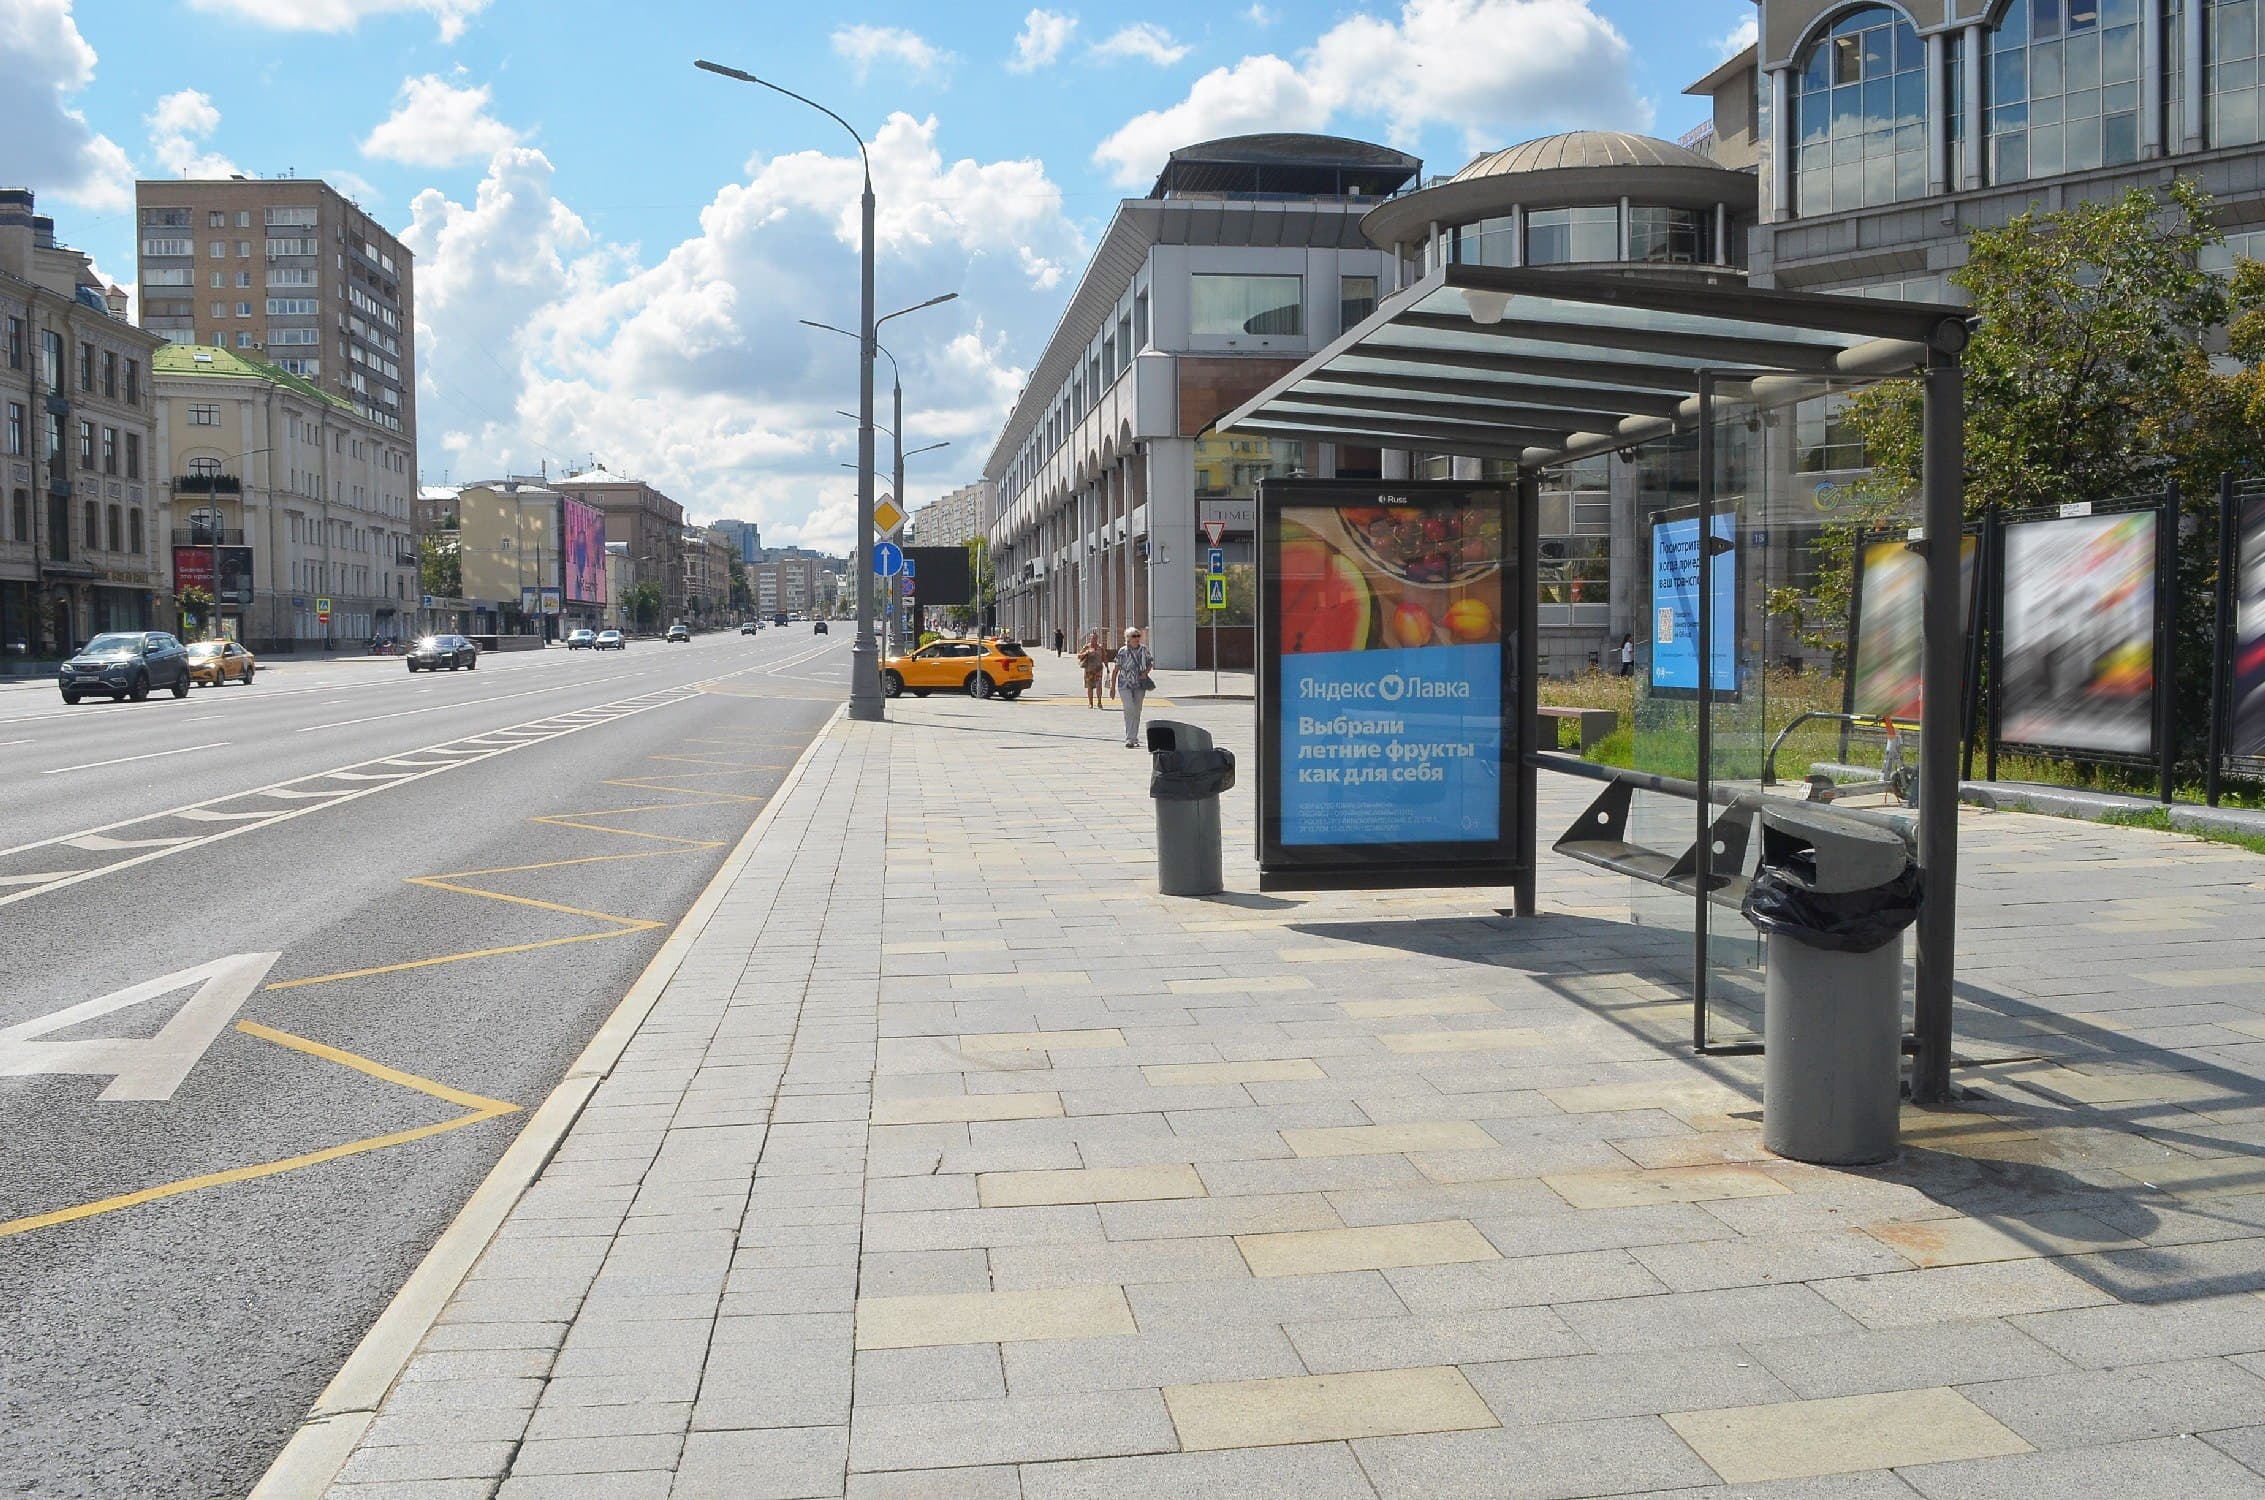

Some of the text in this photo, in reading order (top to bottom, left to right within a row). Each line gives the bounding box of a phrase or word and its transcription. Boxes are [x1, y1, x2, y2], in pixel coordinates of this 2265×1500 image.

[1388, 495, 1407, 503] Russ
[1659, 578, 1673, 588] ваш
[1300, 677, 1470, 700] Яндекс Лавка
[1299, 716, 1404, 737] Выбрали
[1298, 740, 1474, 762] летние фрукты
[1299, 763, 1443, 785] как для себя
